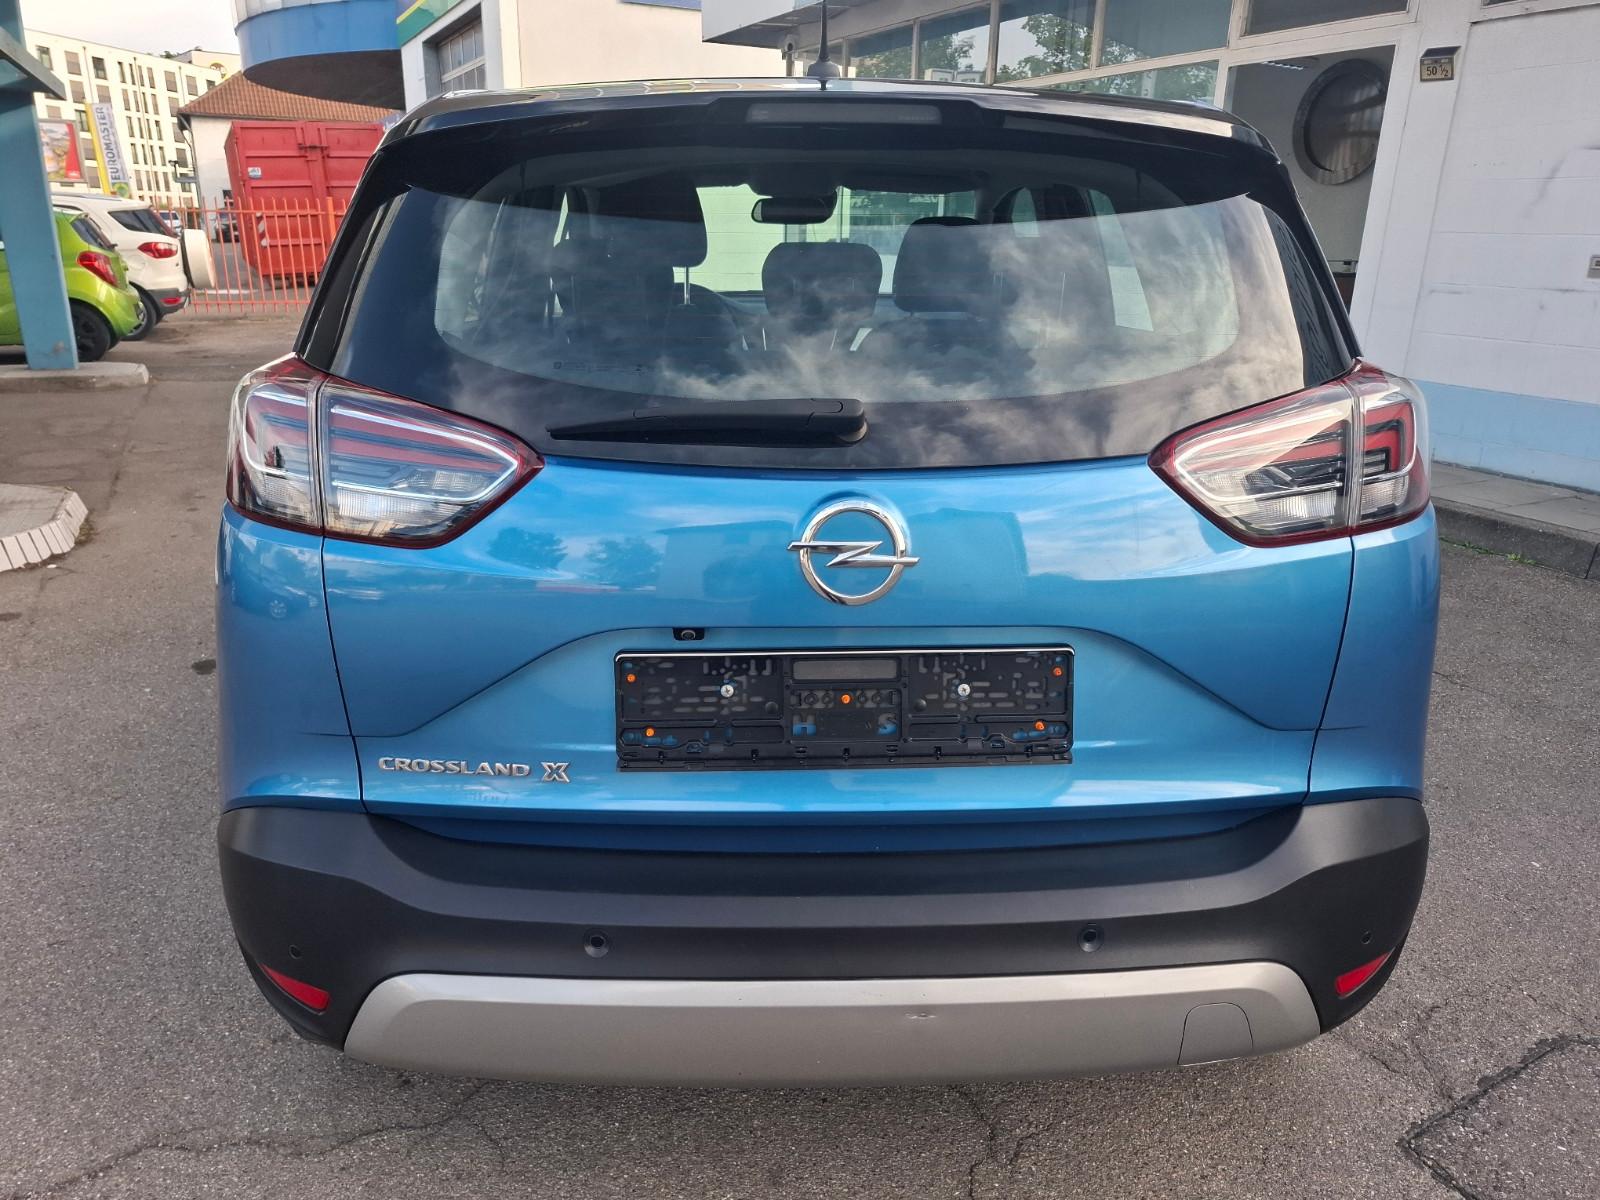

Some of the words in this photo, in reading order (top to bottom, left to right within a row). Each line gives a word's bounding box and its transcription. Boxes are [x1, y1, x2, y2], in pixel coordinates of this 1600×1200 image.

[1427, 65, 1437, 76] 50
[96, 106, 120, 180] EUROMASTER
[378, 756, 531, 777] CROSSLAND
[540, 761, 570, 783] X
